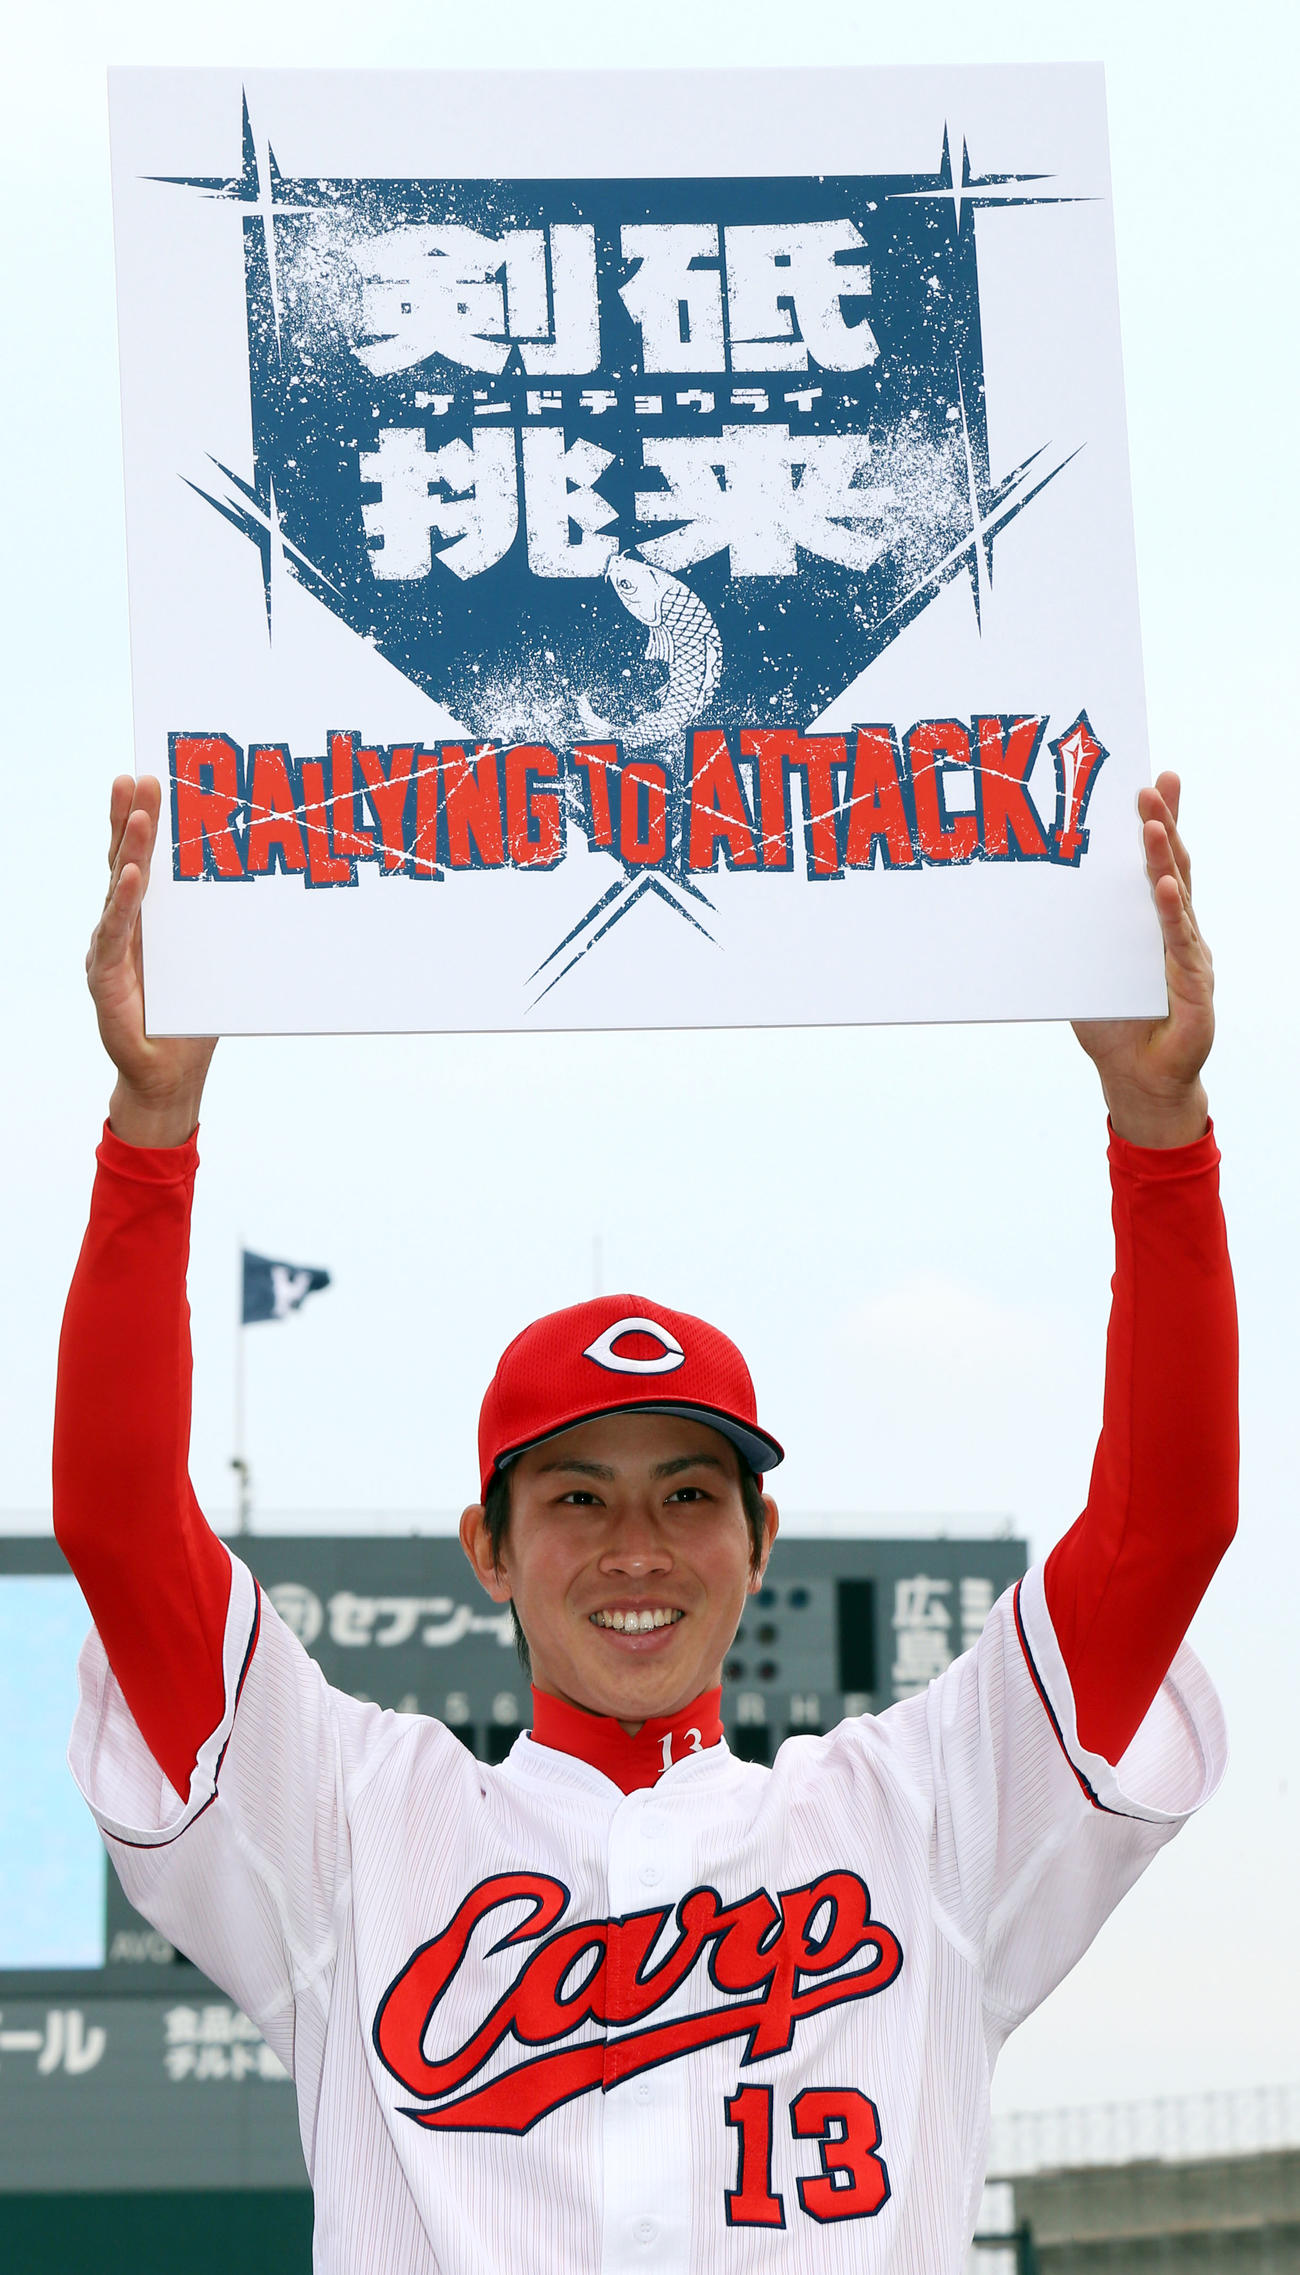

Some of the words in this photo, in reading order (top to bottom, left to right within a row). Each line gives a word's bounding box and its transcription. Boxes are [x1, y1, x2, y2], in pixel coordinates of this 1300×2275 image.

[414, 386, 823, 416] ケンドチョウライ
[358, 424, 894, 582] 挑来
[167, 730, 566, 889] RALLYING
[564, 740, 678, 872] TO
[657, 1727, 704, 1773] 13
[372, 1868, 904, 2137] Carp
[724, 2082, 892, 2230] 13
